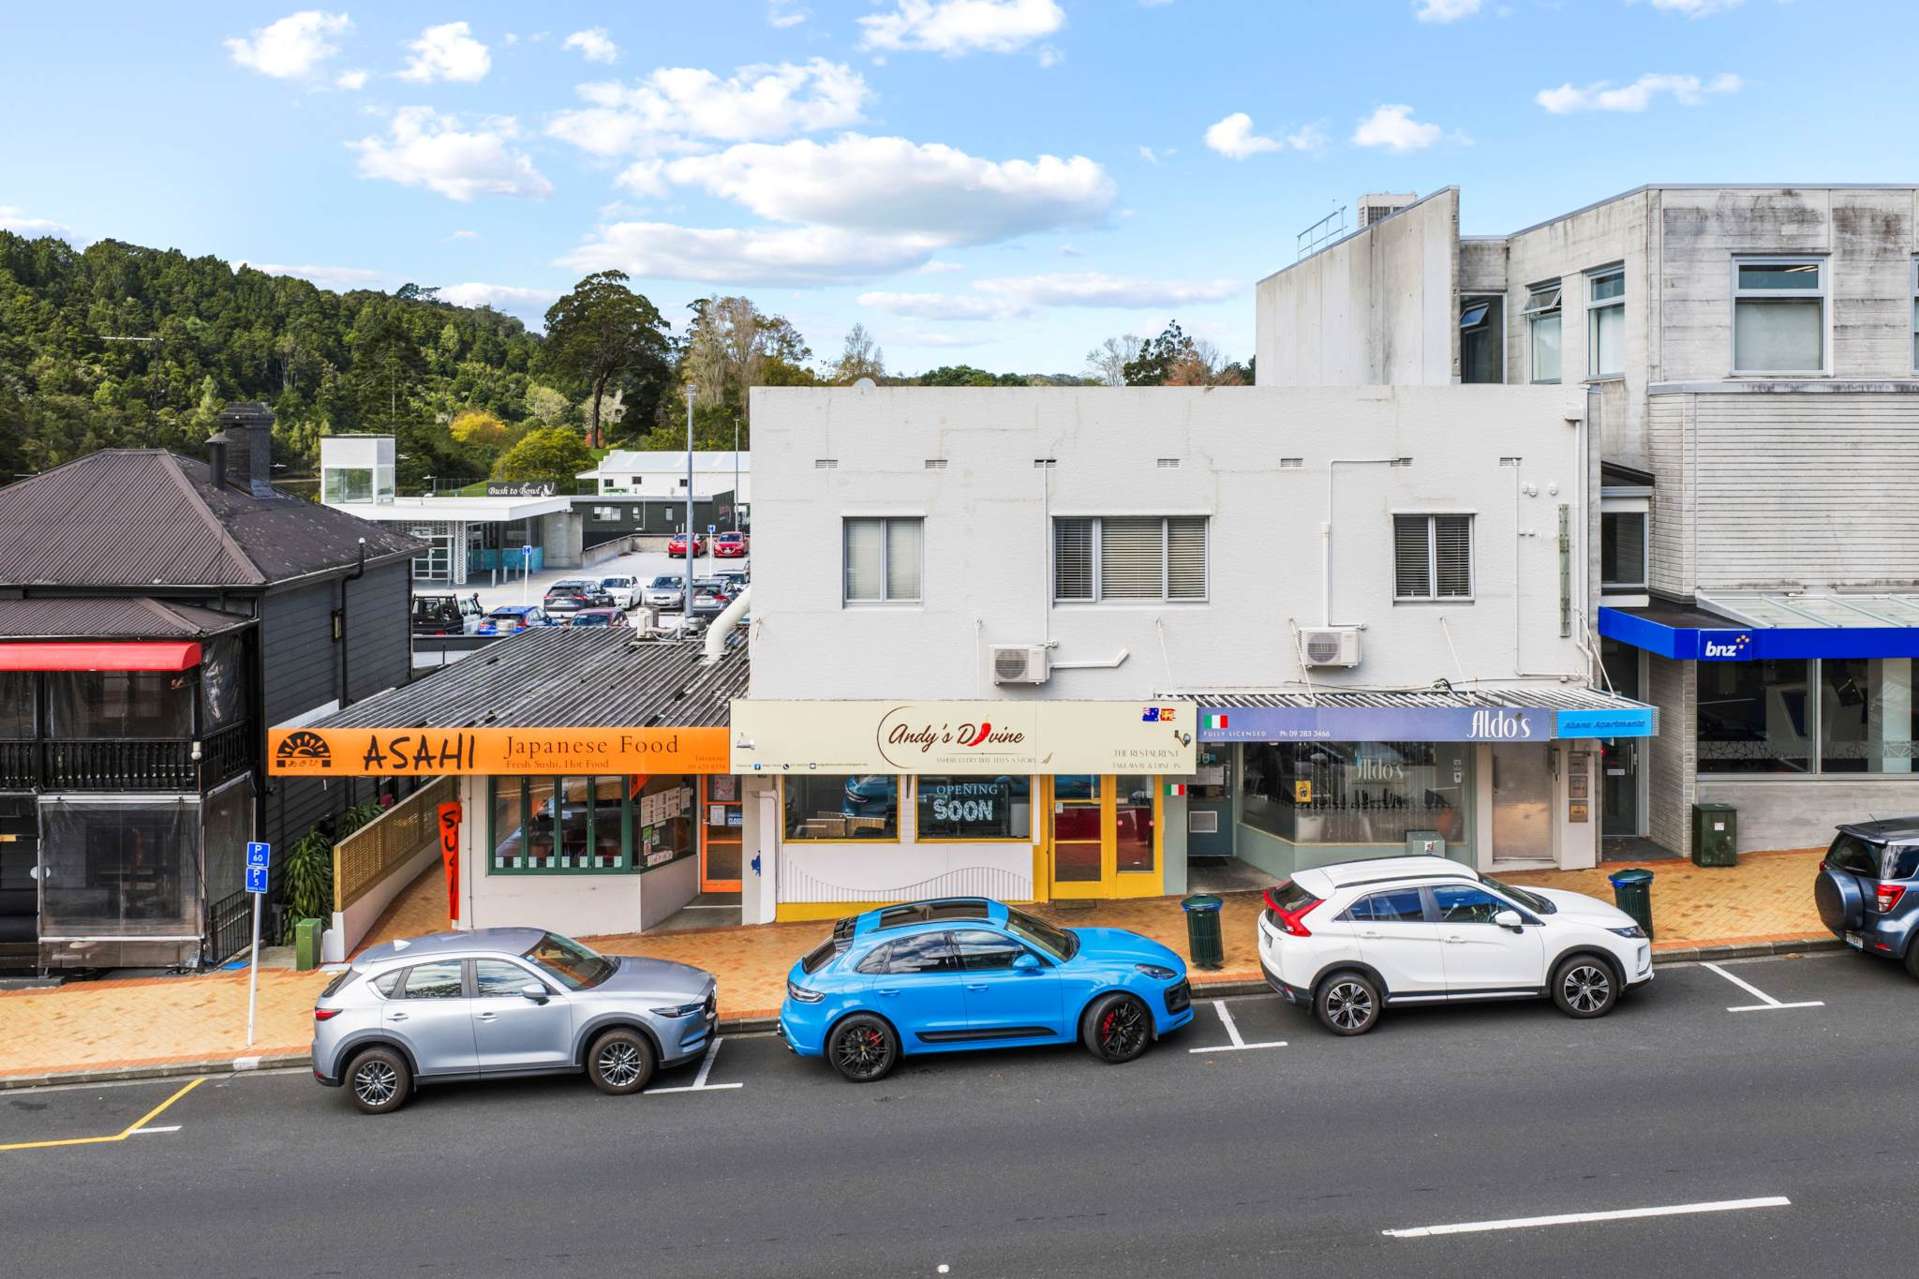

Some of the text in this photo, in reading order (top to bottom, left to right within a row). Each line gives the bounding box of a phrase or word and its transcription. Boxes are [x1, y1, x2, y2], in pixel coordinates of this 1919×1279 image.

[509, 487, 518, 495] to
[1705, 641, 1737, 657] bnz
[1467, 710, 1531, 738] Aldo's
[888, 723, 953, 752] Andy's
[363, 733, 475, 771] ASAHI
[503, 735, 678, 759] Japanese Food
[507, 760, 532, 769] Fresh
[586, 759, 609, 769] Food
[936, 784, 998, 795] OPENING
[933, 799, 993, 821] SOON
[255, 845, 263, 854] P
[253, 870, 260, 878] P
